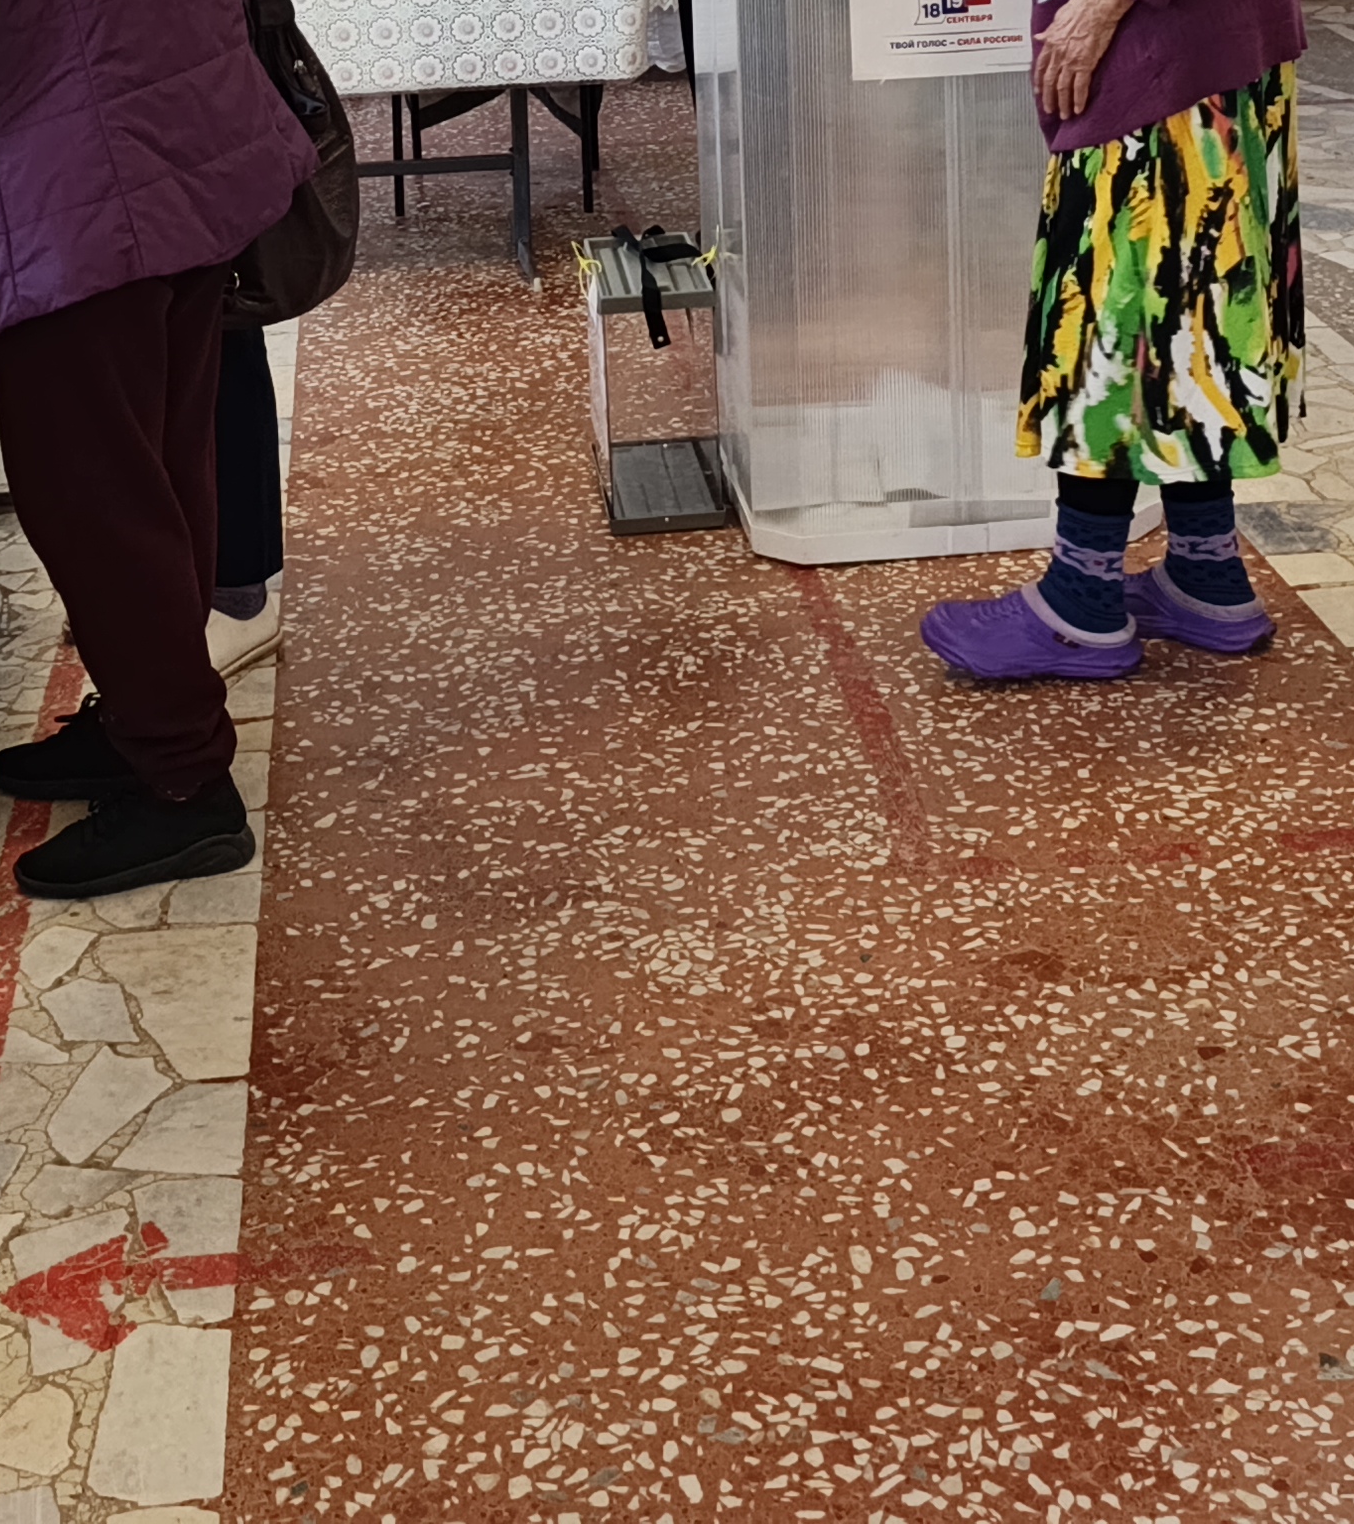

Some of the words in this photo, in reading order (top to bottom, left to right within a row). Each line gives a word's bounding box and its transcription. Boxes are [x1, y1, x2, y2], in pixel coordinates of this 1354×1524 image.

[921, 3, 940, 18] 18
[946, 14, 993, 24] СЕНТЯБРЯ
[890, 40, 915, 49] ТВОЙ
[916, 40, 947, 48] ГОЛОС
[957, 37, 982, 46] СИЛА
